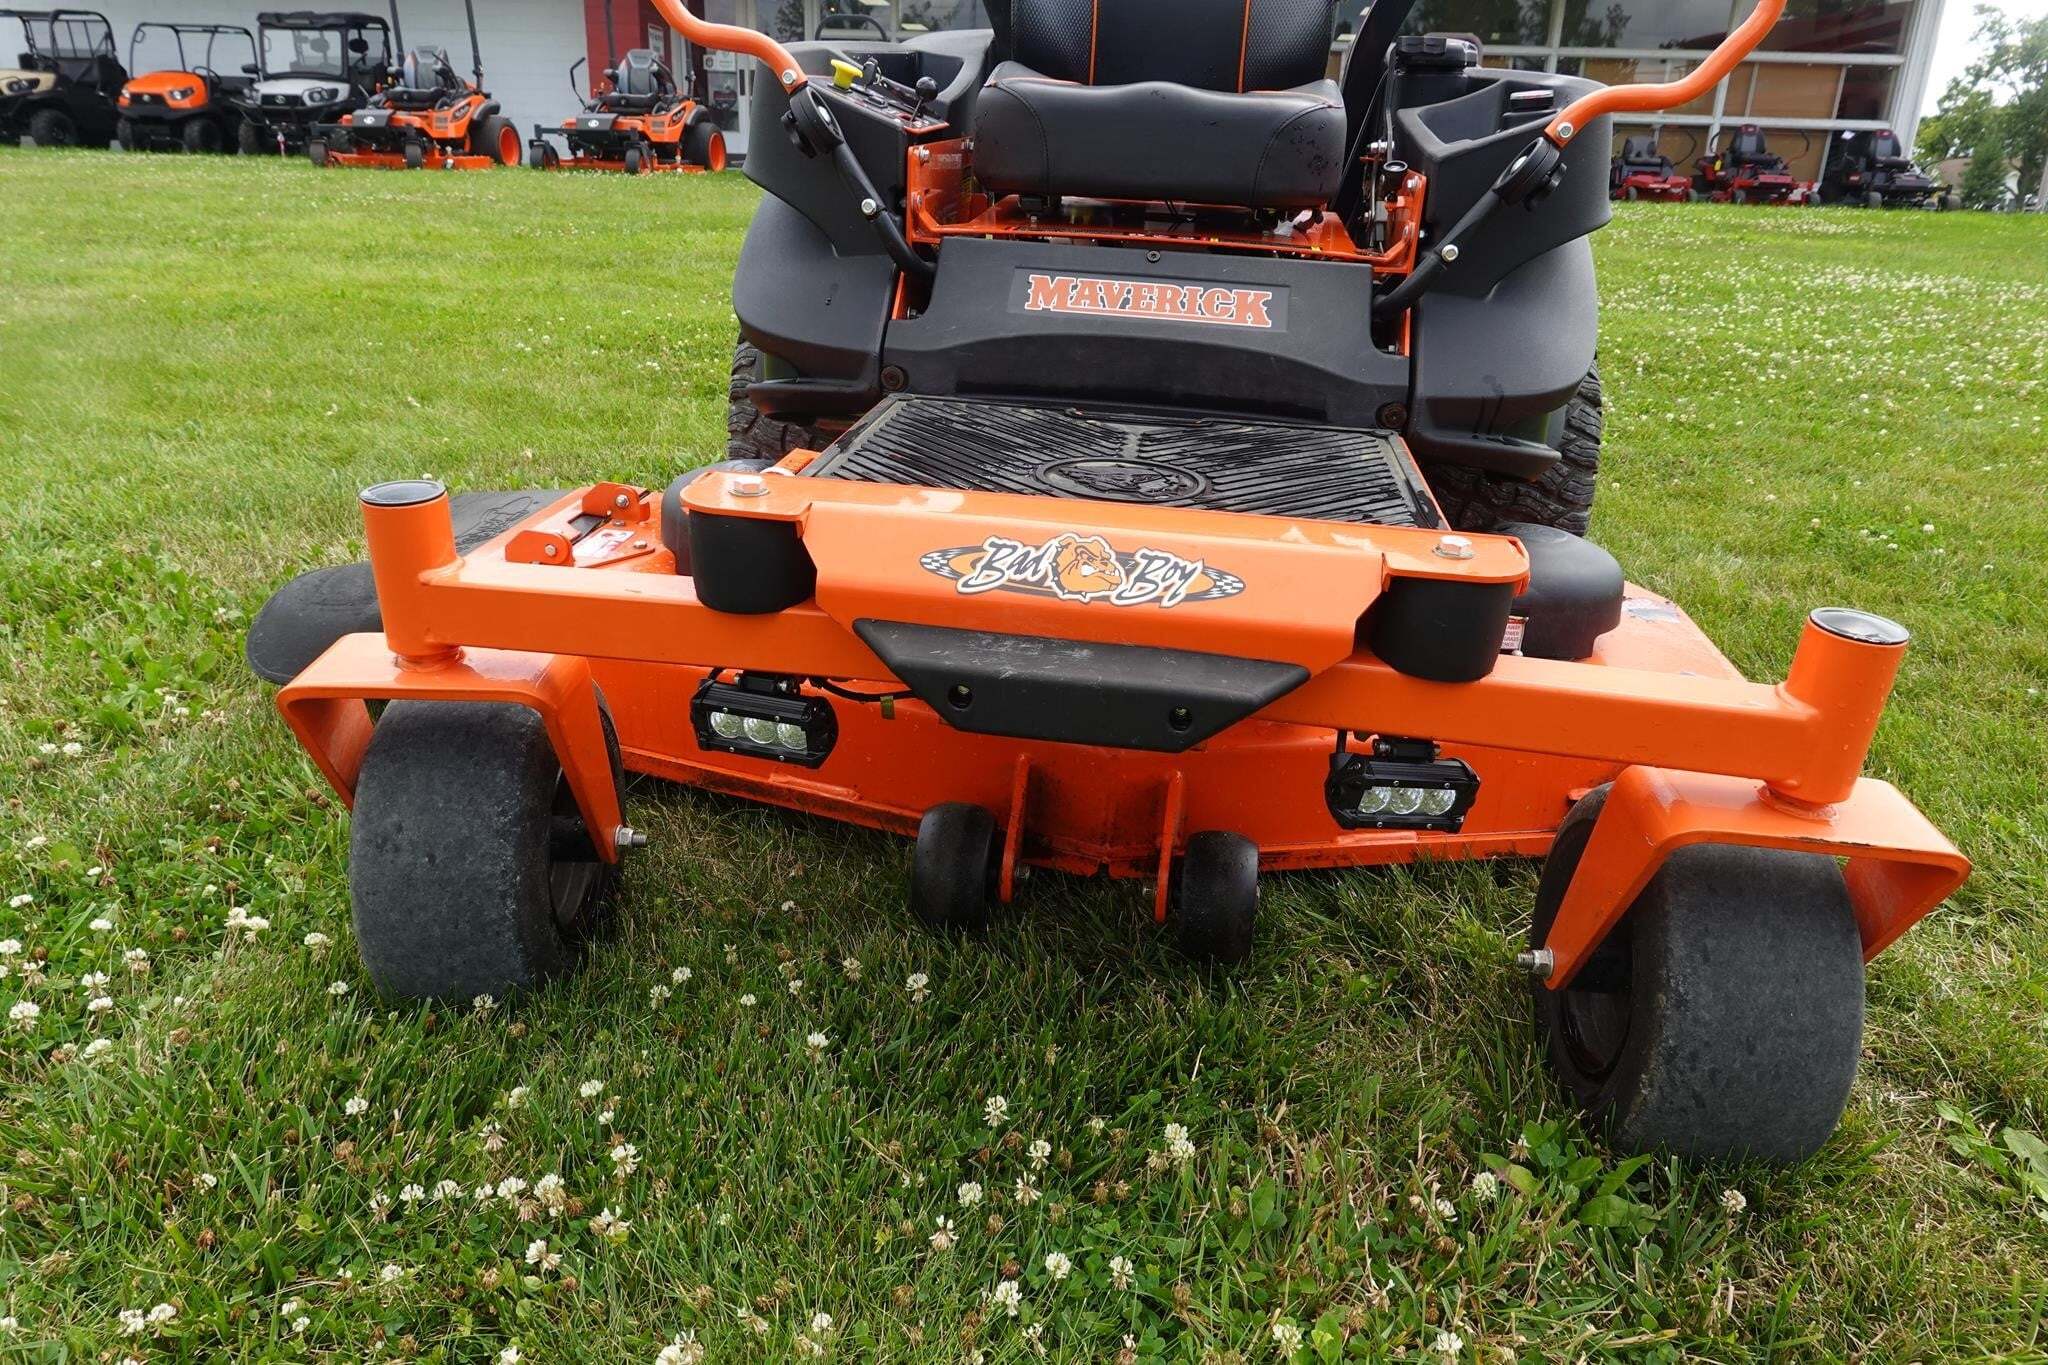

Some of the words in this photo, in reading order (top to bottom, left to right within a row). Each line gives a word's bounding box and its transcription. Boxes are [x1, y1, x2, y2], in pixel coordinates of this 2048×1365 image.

[1025, 274, 1272, 328] MAVERICK
[957, 537, 1054, 593] Bad
[1112, 549, 1204, 606] Boy
